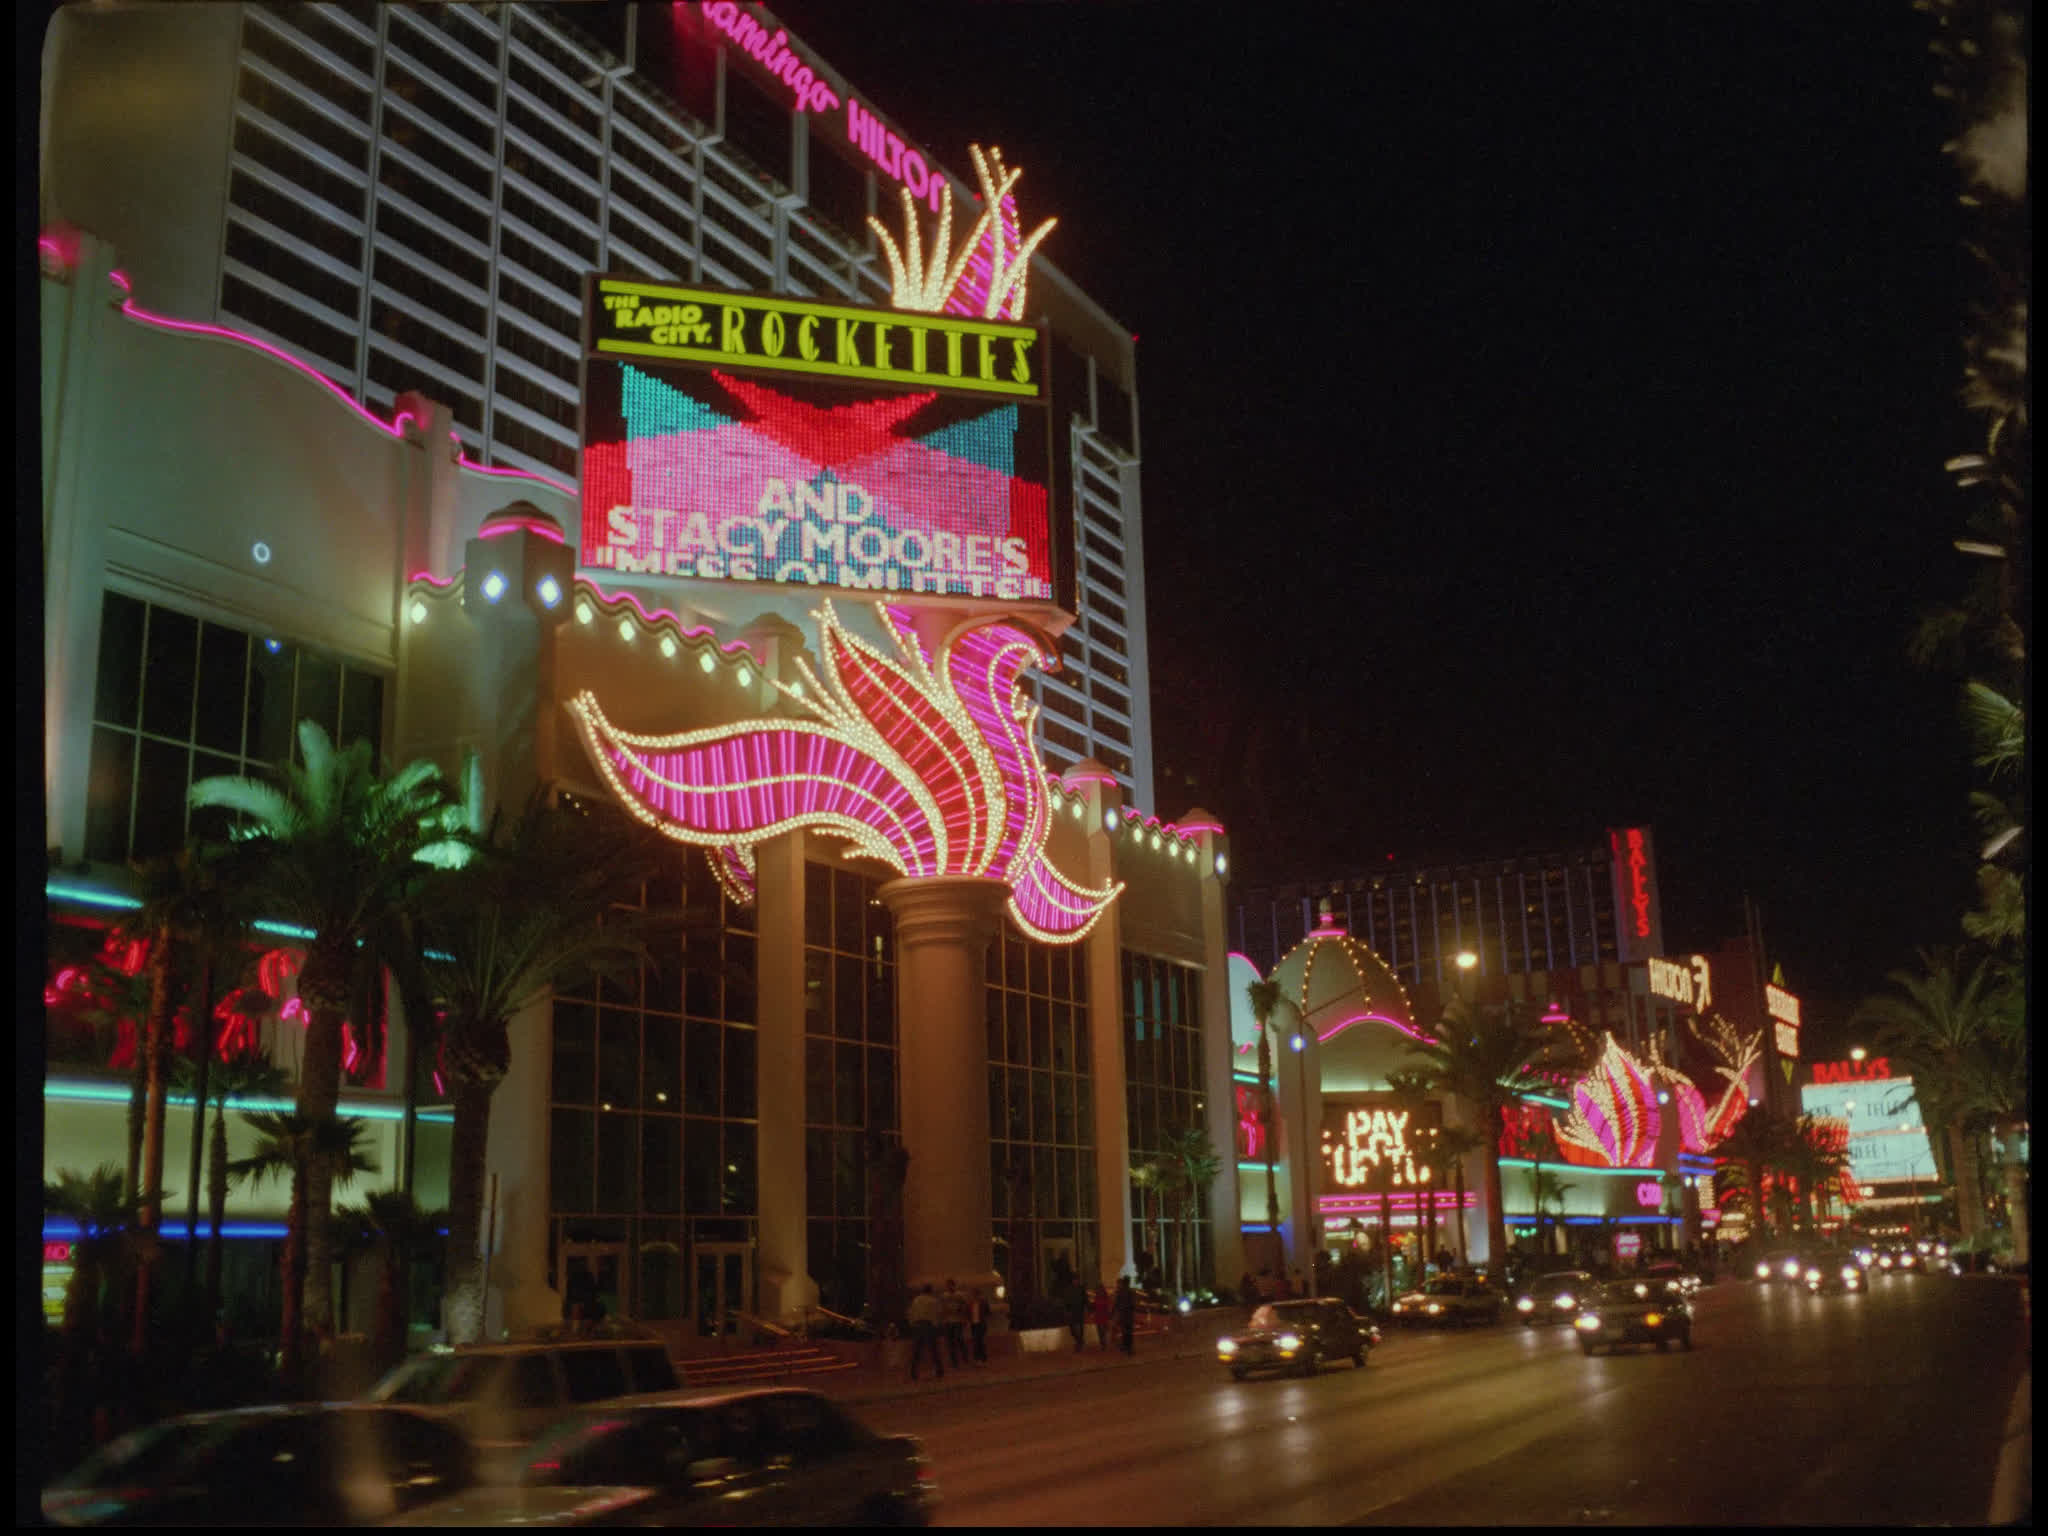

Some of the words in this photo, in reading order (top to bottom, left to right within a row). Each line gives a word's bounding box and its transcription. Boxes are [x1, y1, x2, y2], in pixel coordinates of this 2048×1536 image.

[603, 295, 641, 311] THE
[615, 304, 703, 329] RADIO
[720, 304, 1034, 385] ROCKETTES
[757, 476, 874, 523] AND
[607, 504, 790, 559] STACY
[800, 519, 1031, 576] MOORE'S
[1346, 1109, 1410, 1150] PAY
